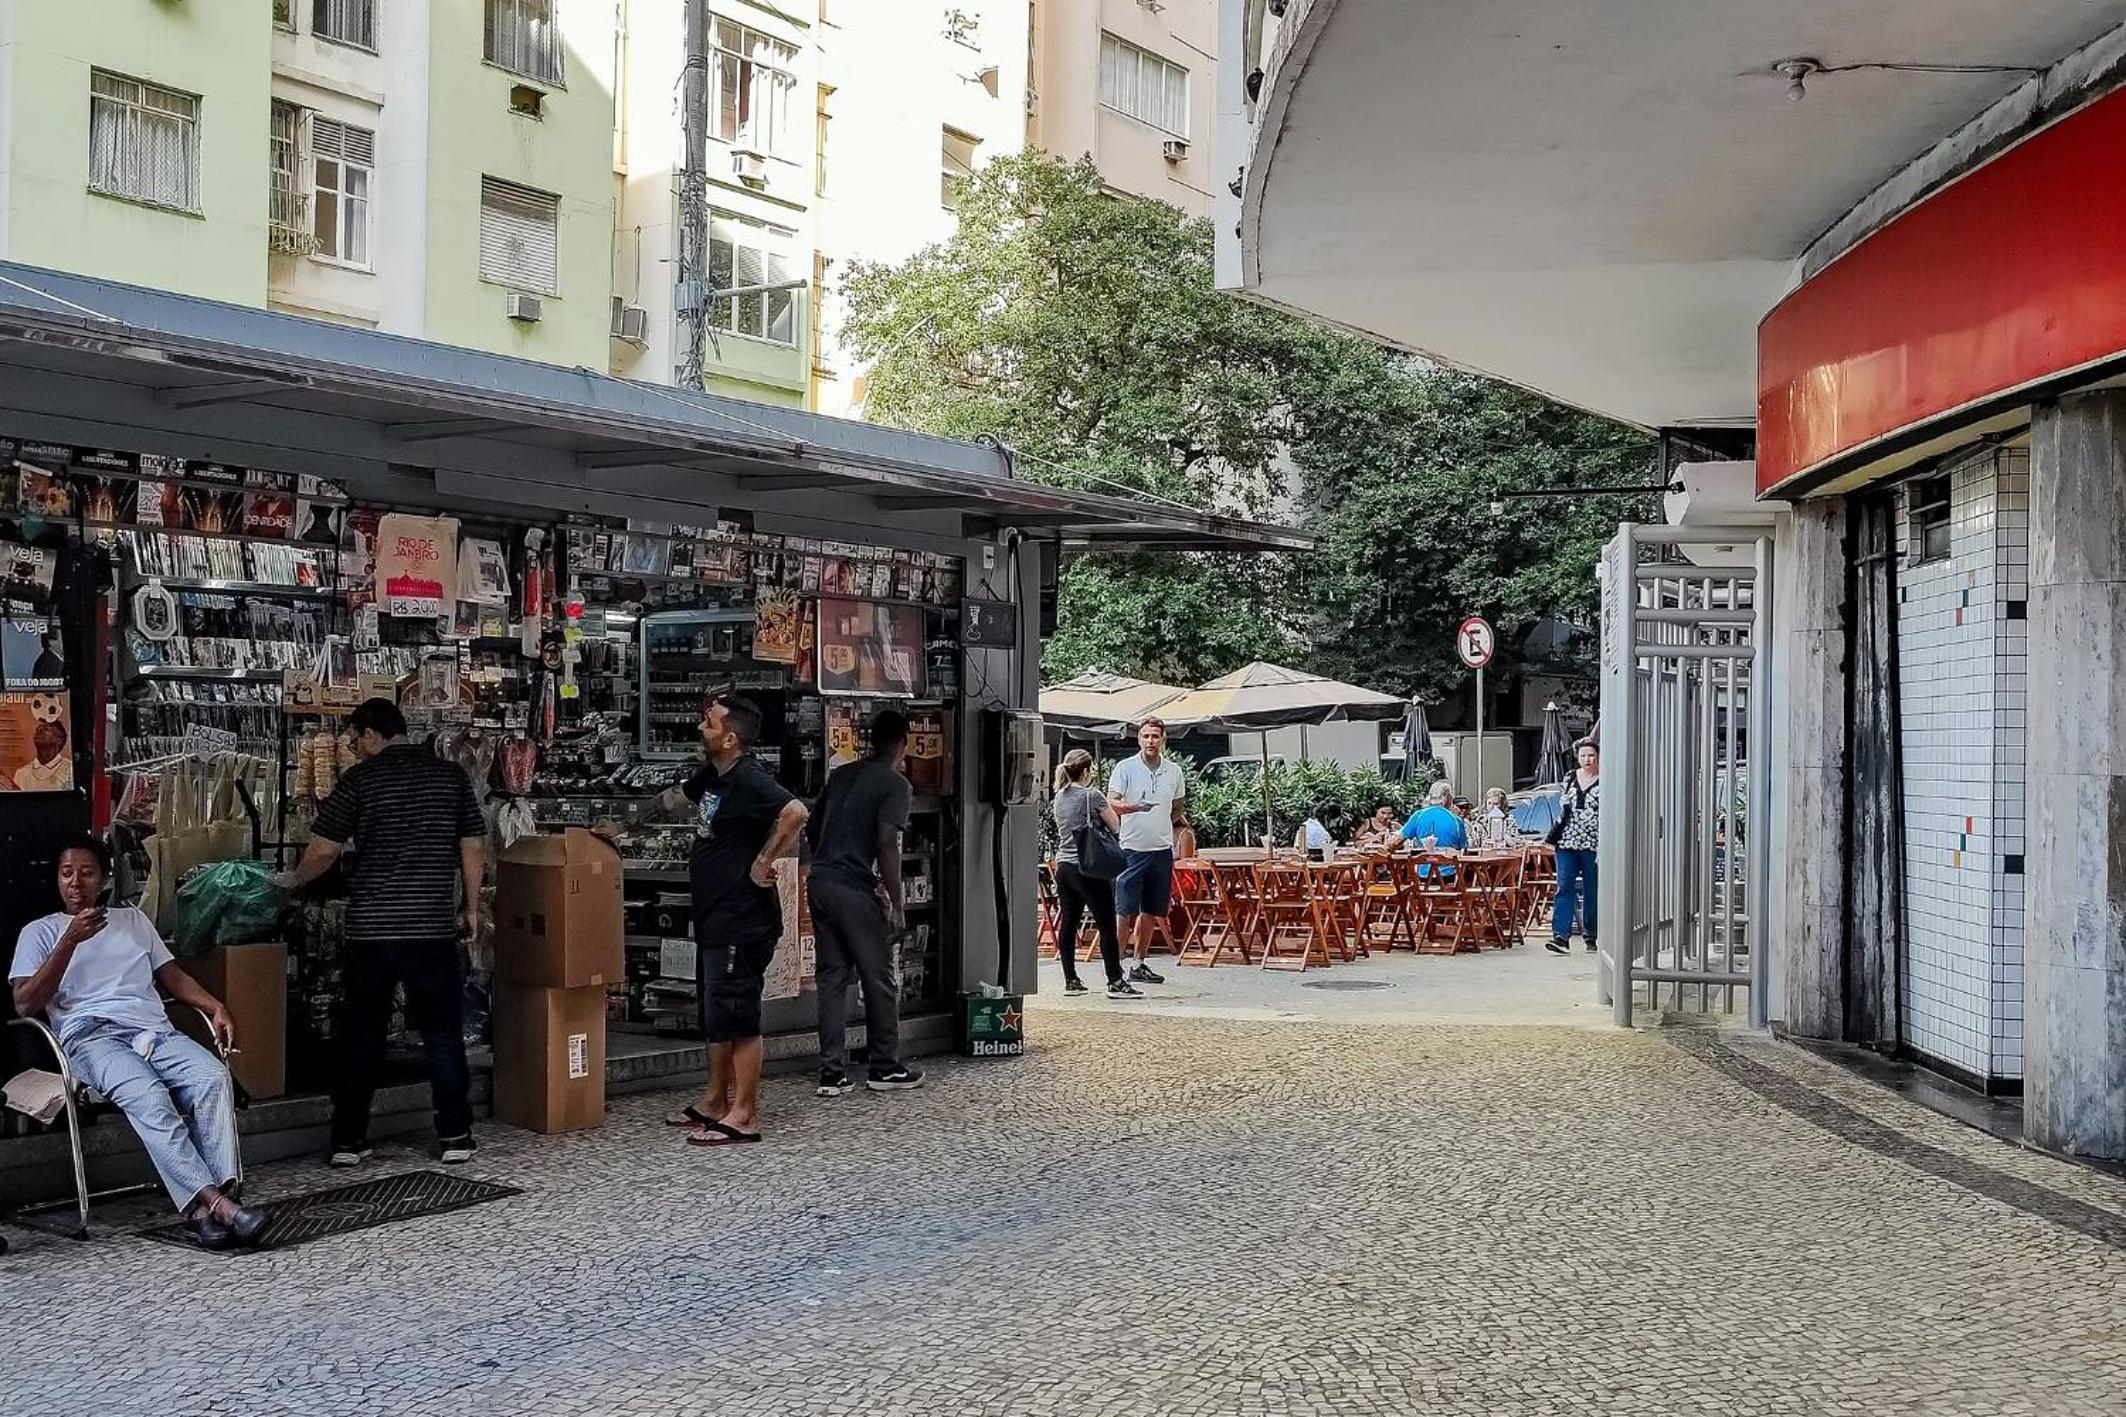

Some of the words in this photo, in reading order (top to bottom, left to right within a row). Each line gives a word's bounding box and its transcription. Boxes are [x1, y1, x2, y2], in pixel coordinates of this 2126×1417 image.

[398, 536, 416, 549] RIO
[420, 540, 434, 550] DE
[10, 545, 43, 562] veja
[393, 547, 439, 560] JANEIRO
[13, 621, 48, 636] veja
[1470, 629, 1480, 656] E
